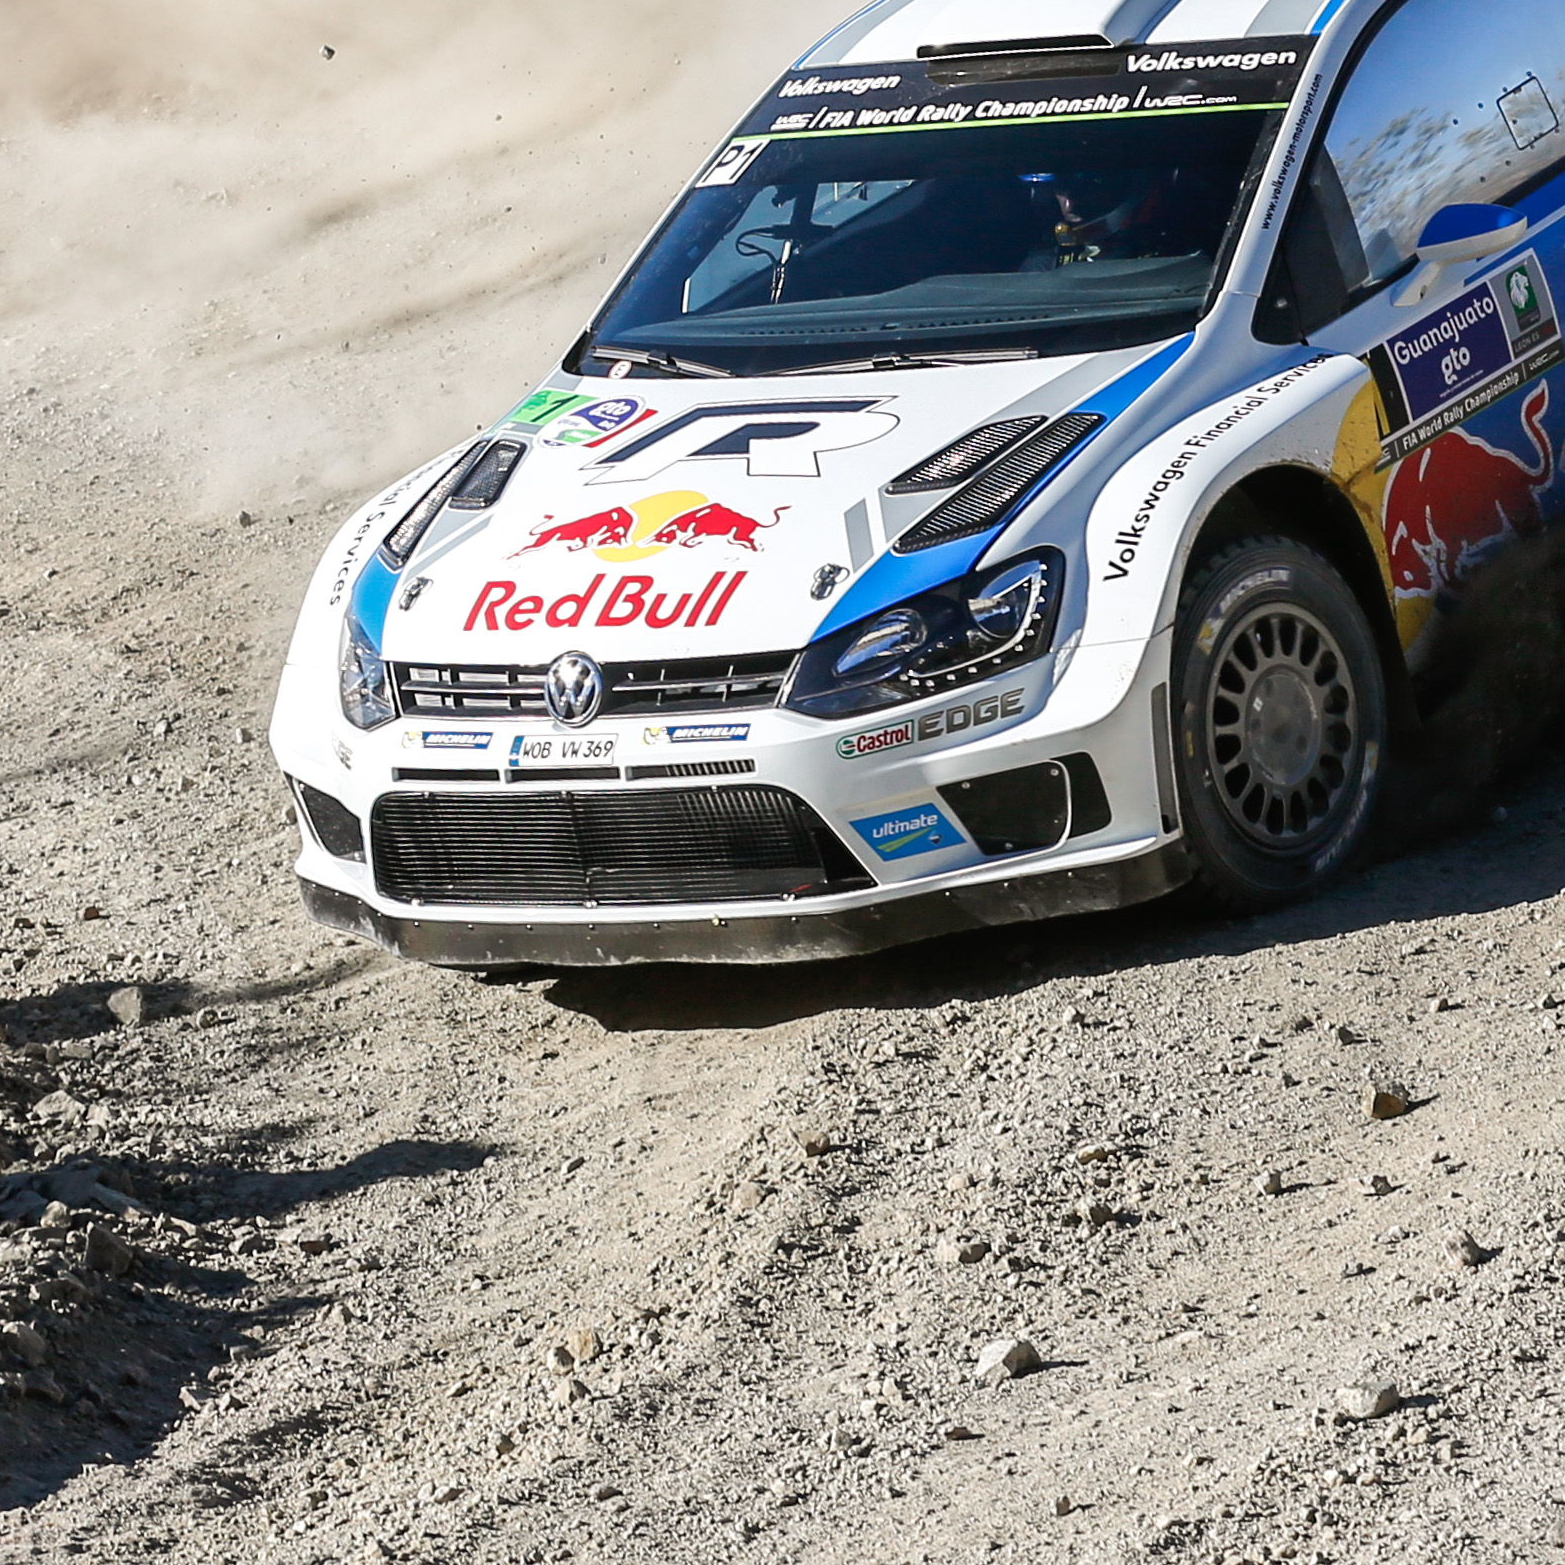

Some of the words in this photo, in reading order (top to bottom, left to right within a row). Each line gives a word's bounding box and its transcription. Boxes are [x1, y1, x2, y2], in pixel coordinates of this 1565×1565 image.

[1125, 50, 1297, 73] Volkswagen
[778, 74, 902, 98] Volkswagen
[817, 111, 853, 129] FIA
[856, 105, 917, 126] World
[916, 102, 973, 123] Rally
[974, 92, 1130, 119] Championship
[701, 143, 764, 183] P1
[1262, 73, 1323, 230] www.volkswagen-motorsport.com
[1394, 296, 1495, 365] Guanajuato
[1441, 346, 1470, 385] gto
[1402, 434, 1418, 451] FIA
[1417, 418, 1442, 441] World
[1443, 404, 1464, 426] Rally
[1464, 371, 1520, 411] Championship
[578, 395, 901, 486] R
[1103, 450, 1198, 582] Volkswagen
[1185, 395, 1269, 448] Financial
[1257, 353, 1334, 394] Services
[329, 510, 385, 606] Services
[463, 573, 607, 631] Red
[594, 570, 749, 629] Bull
[426, 732, 489, 746] MICHELIN
[672, 723, 748, 739] MICHELIN
[857, 724, 910, 753] Castrol
[918, 688, 1025, 741] EDGE
[522, 742, 552, 760] WOB
[562, 741, 584, 759] VW
[583, 739, 614, 758] 369
[872, 813, 938, 839] ultimate
